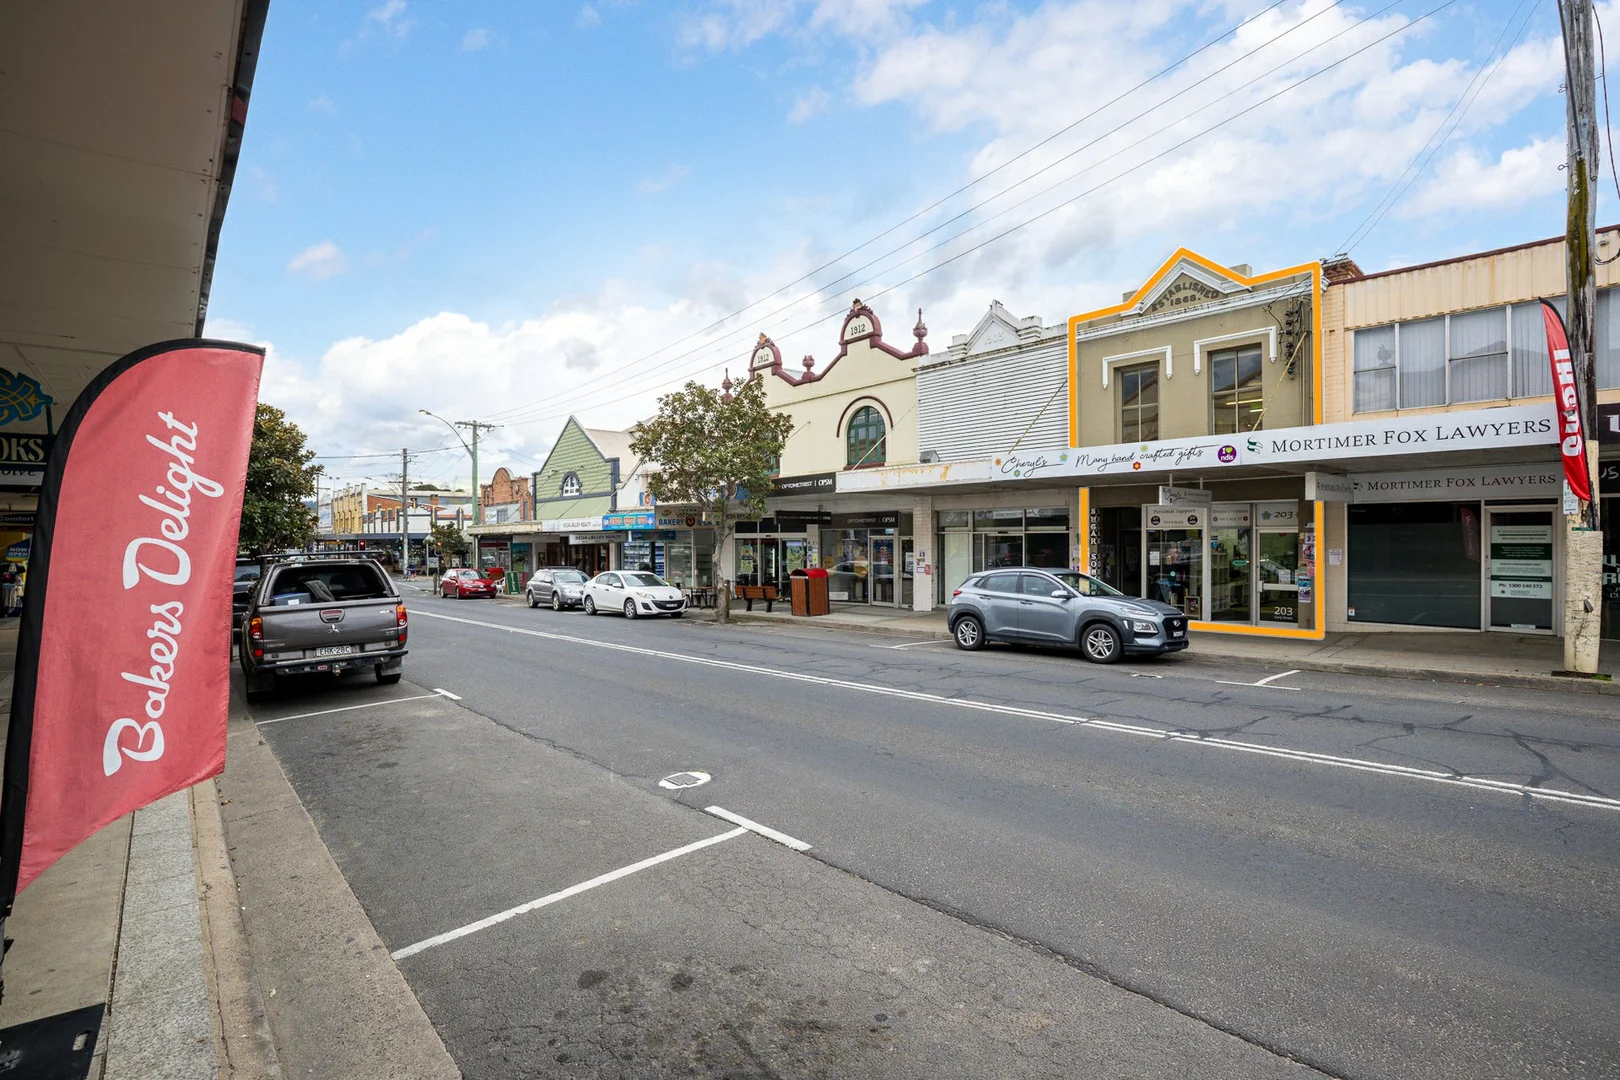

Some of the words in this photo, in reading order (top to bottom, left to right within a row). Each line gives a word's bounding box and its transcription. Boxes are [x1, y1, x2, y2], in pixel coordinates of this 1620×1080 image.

[1152, 282, 1219, 312] ESTABLISHED
[850, 323, 866, 336] 1912
[757, 353, 769, 364] 1912
[1075, 454, 1108, 472] Many
[1111, 452, 1135, 463] hand
[1140, 447, 1180, 463] crafted
[1175, 444, 1215, 466] gifts
[1001, 456, 1062, 477] Cheryl's
[781, 481, 813, 489] OPTOMETRIST
[818, 478, 833, 486] OPSM
[122, 410, 225, 590] Delight
[881, 516, 895, 524] OPSM
[1274, 511, 1293, 519] 203
[658, 518, 684, 526] BAKERY
[1274, 606, 1293, 616] 203
[102, 600, 184, 777] Bakers
